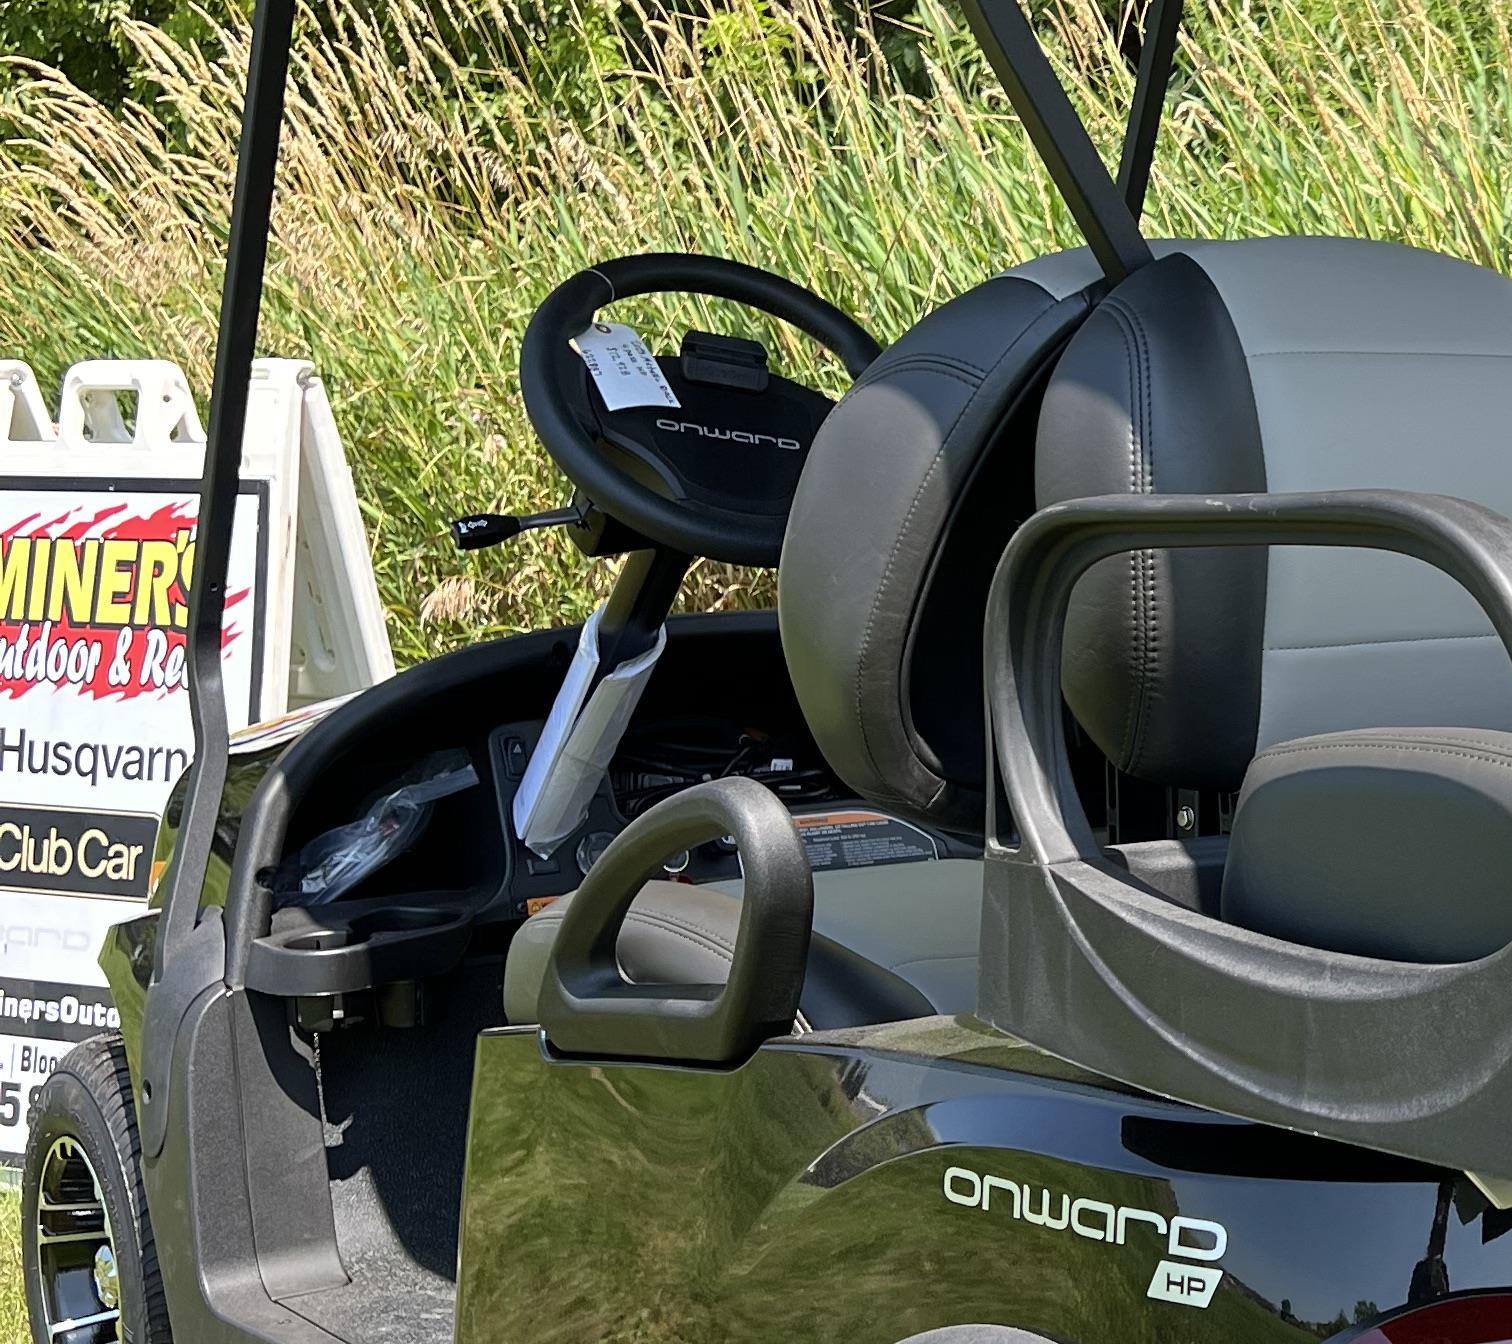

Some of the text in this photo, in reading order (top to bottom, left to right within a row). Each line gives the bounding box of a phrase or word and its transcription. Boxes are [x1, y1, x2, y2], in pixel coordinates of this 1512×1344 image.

[108, 626, 132, 687] &
[140, 628, 188, 690] Re
[0, 822, 143, 881] Club Car
[1165, 1271, 1207, 1297] HP
